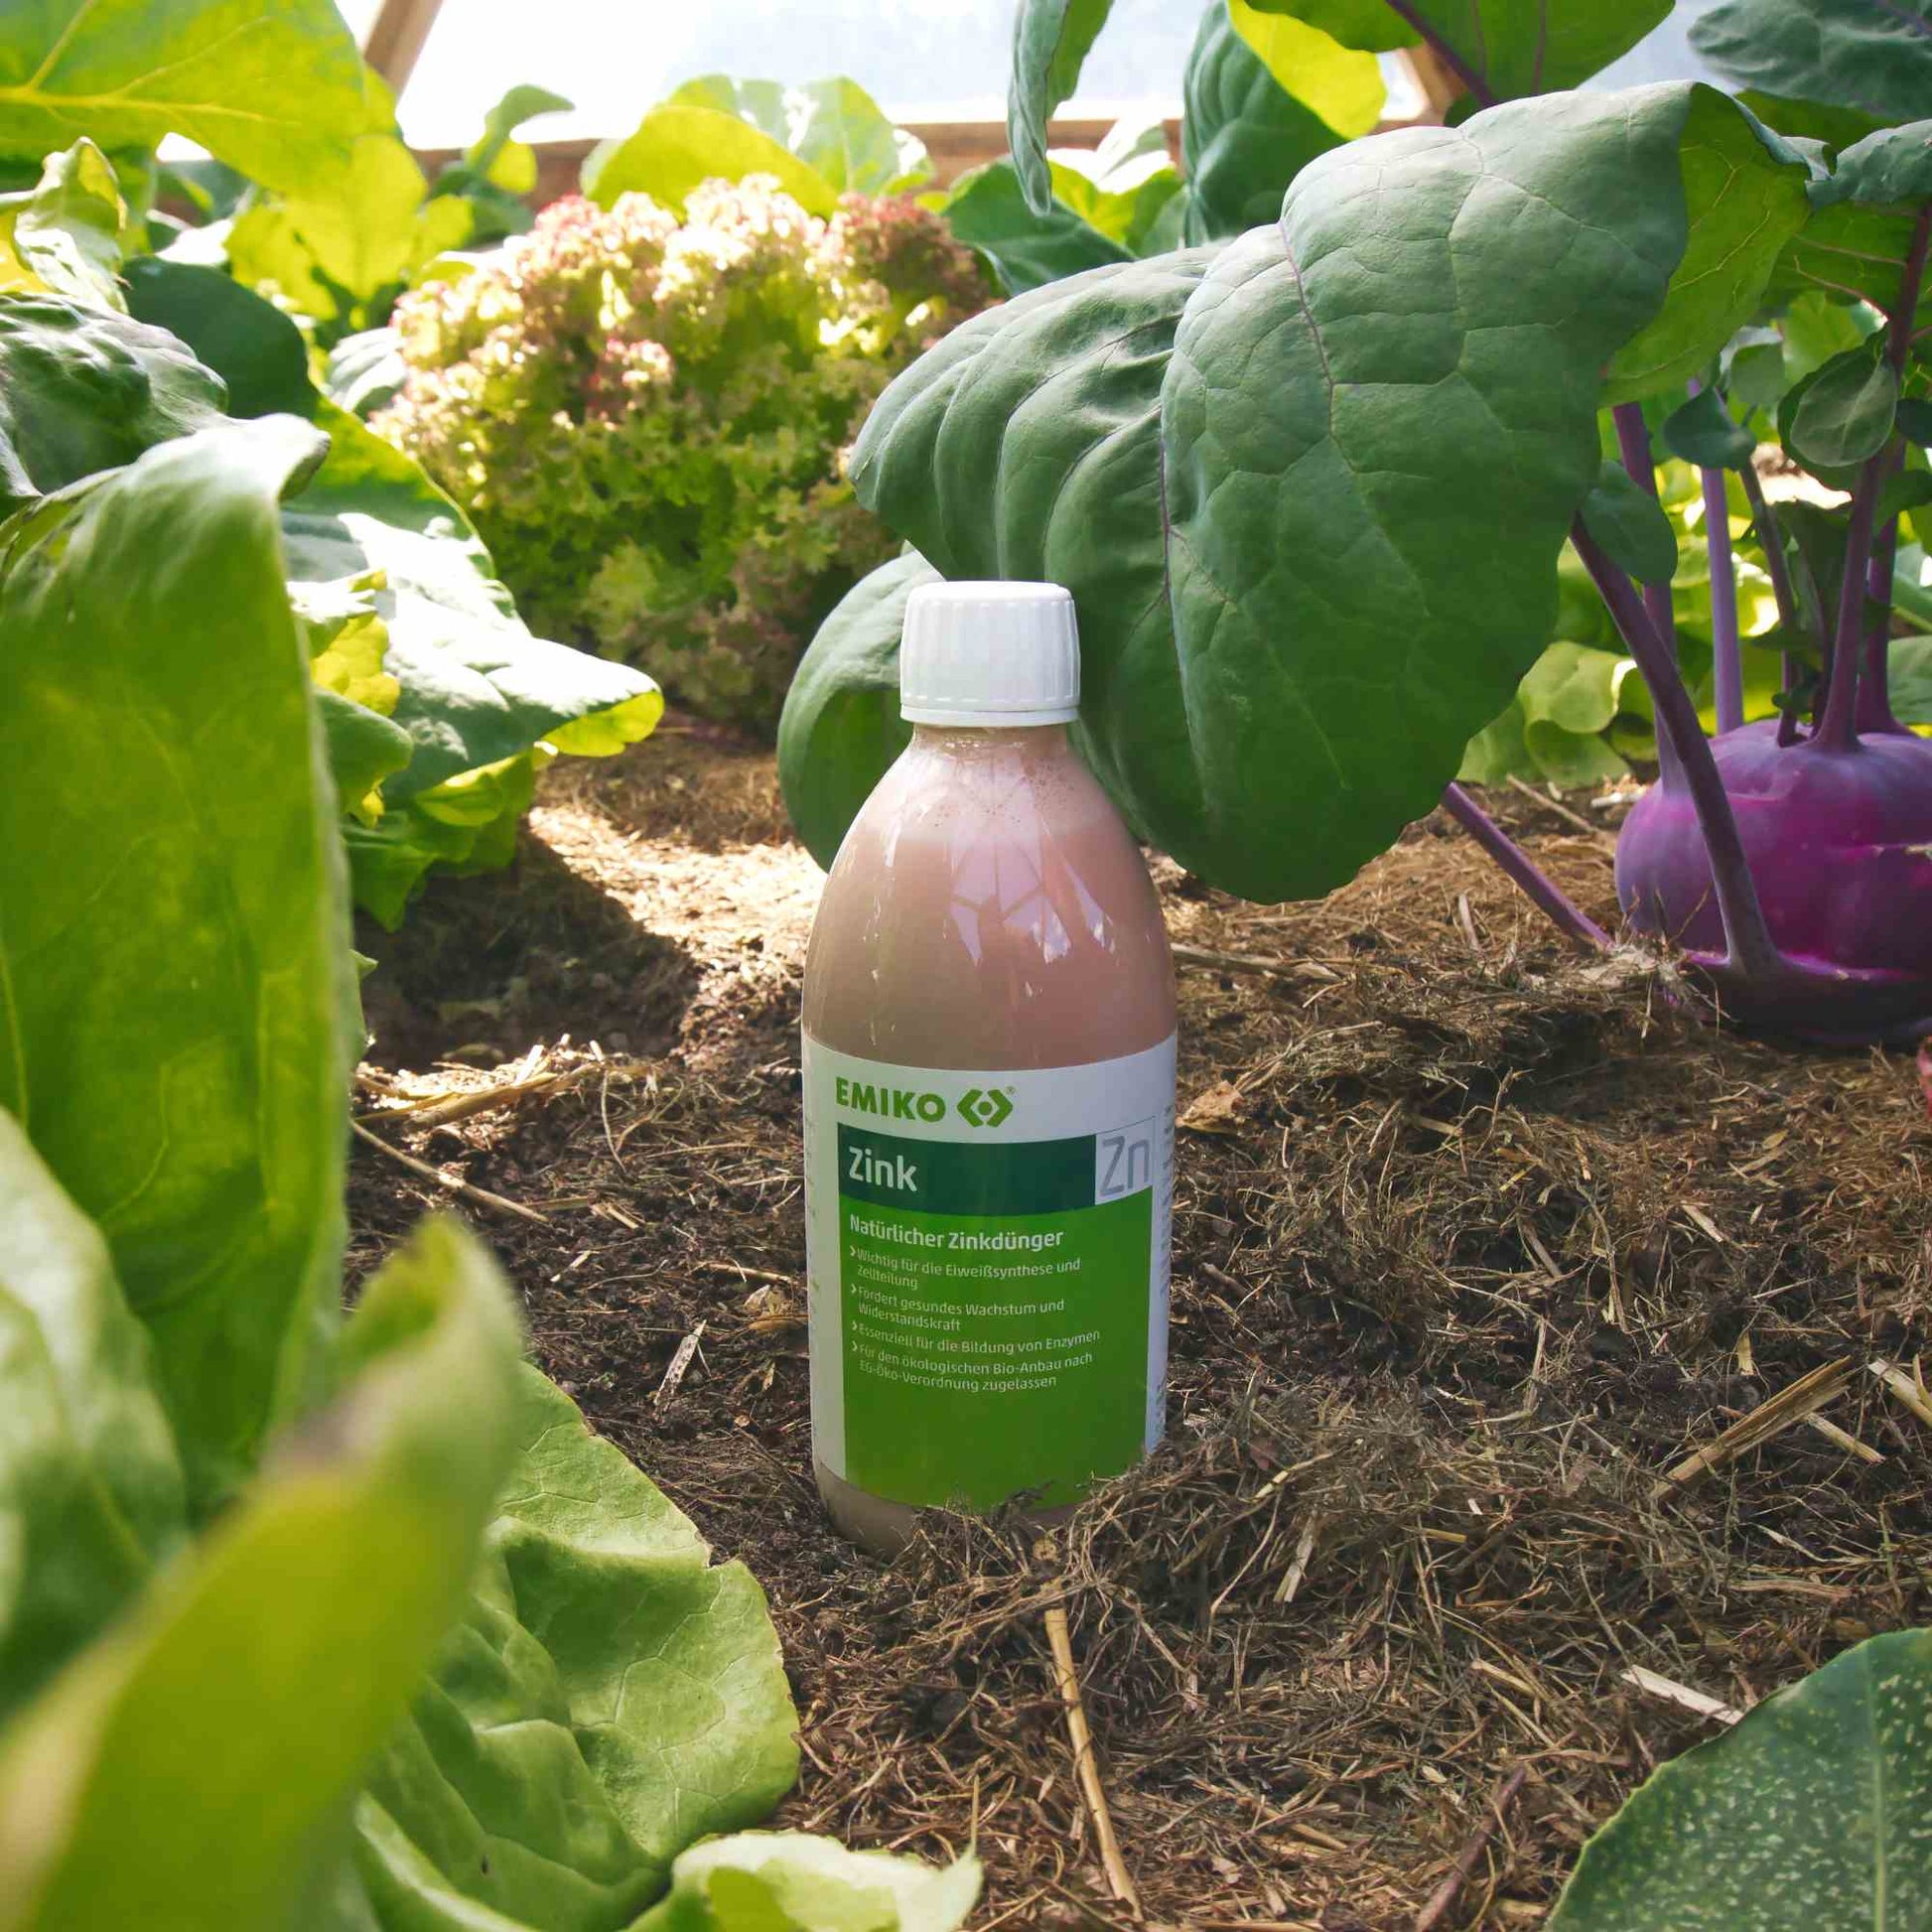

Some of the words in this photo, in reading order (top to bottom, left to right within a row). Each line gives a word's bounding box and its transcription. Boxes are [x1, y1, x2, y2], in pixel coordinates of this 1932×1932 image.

[836, 1077, 946, 1123] EMIKO
[849, 1147, 917, 1191] Zink
[1099, 1136, 1150, 1196] Zn
[850, 1214, 944, 1248] Natürlicher
[948, 1231, 1063, 1252] Zinkdünger
[857, 1264, 918, 1291] Zellteilung
[858, 1247, 897, 1271] Wichtig
[901, 1258, 919, 1272] für
[921, 1262, 942, 1276] die
[945, 1264, 1053, 1280] Eiweißsynthese
[1056, 1257, 1081, 1273] und
[859, 1286, 897, 1307] Fördert
[900, 1299, 962, 1314] gesundes
[965, 1304, 1035, 1315] Wachstum
[1039, 1299, 1064, 1312] und
[859, 1302, 960, 1331] Widerstandskraft
[859, 1322, 912, 1346] Essenziell
[916, 1335, 934, 1349] für
[937, 1338, 958, 1352] die
[961, 1340, 1014, 1355] Bildung
[1017, 1342, 1042, 1352] von
[1045, 1330, 1100, 1349] Enzymen
[859, 1359, 979, 1393] EG-Öko-Verordnung
[982, 1376, 1057, 1393] zugelassen
[860, 1344, 875, 1357] Für
[878, 1351, 899, 1365] den
[902, 1356, 990, 1375] ökologischen
[993, 1360, 1061, 1374] Bio-Anbau
[1064, 1352, 1092, 1368] nach
